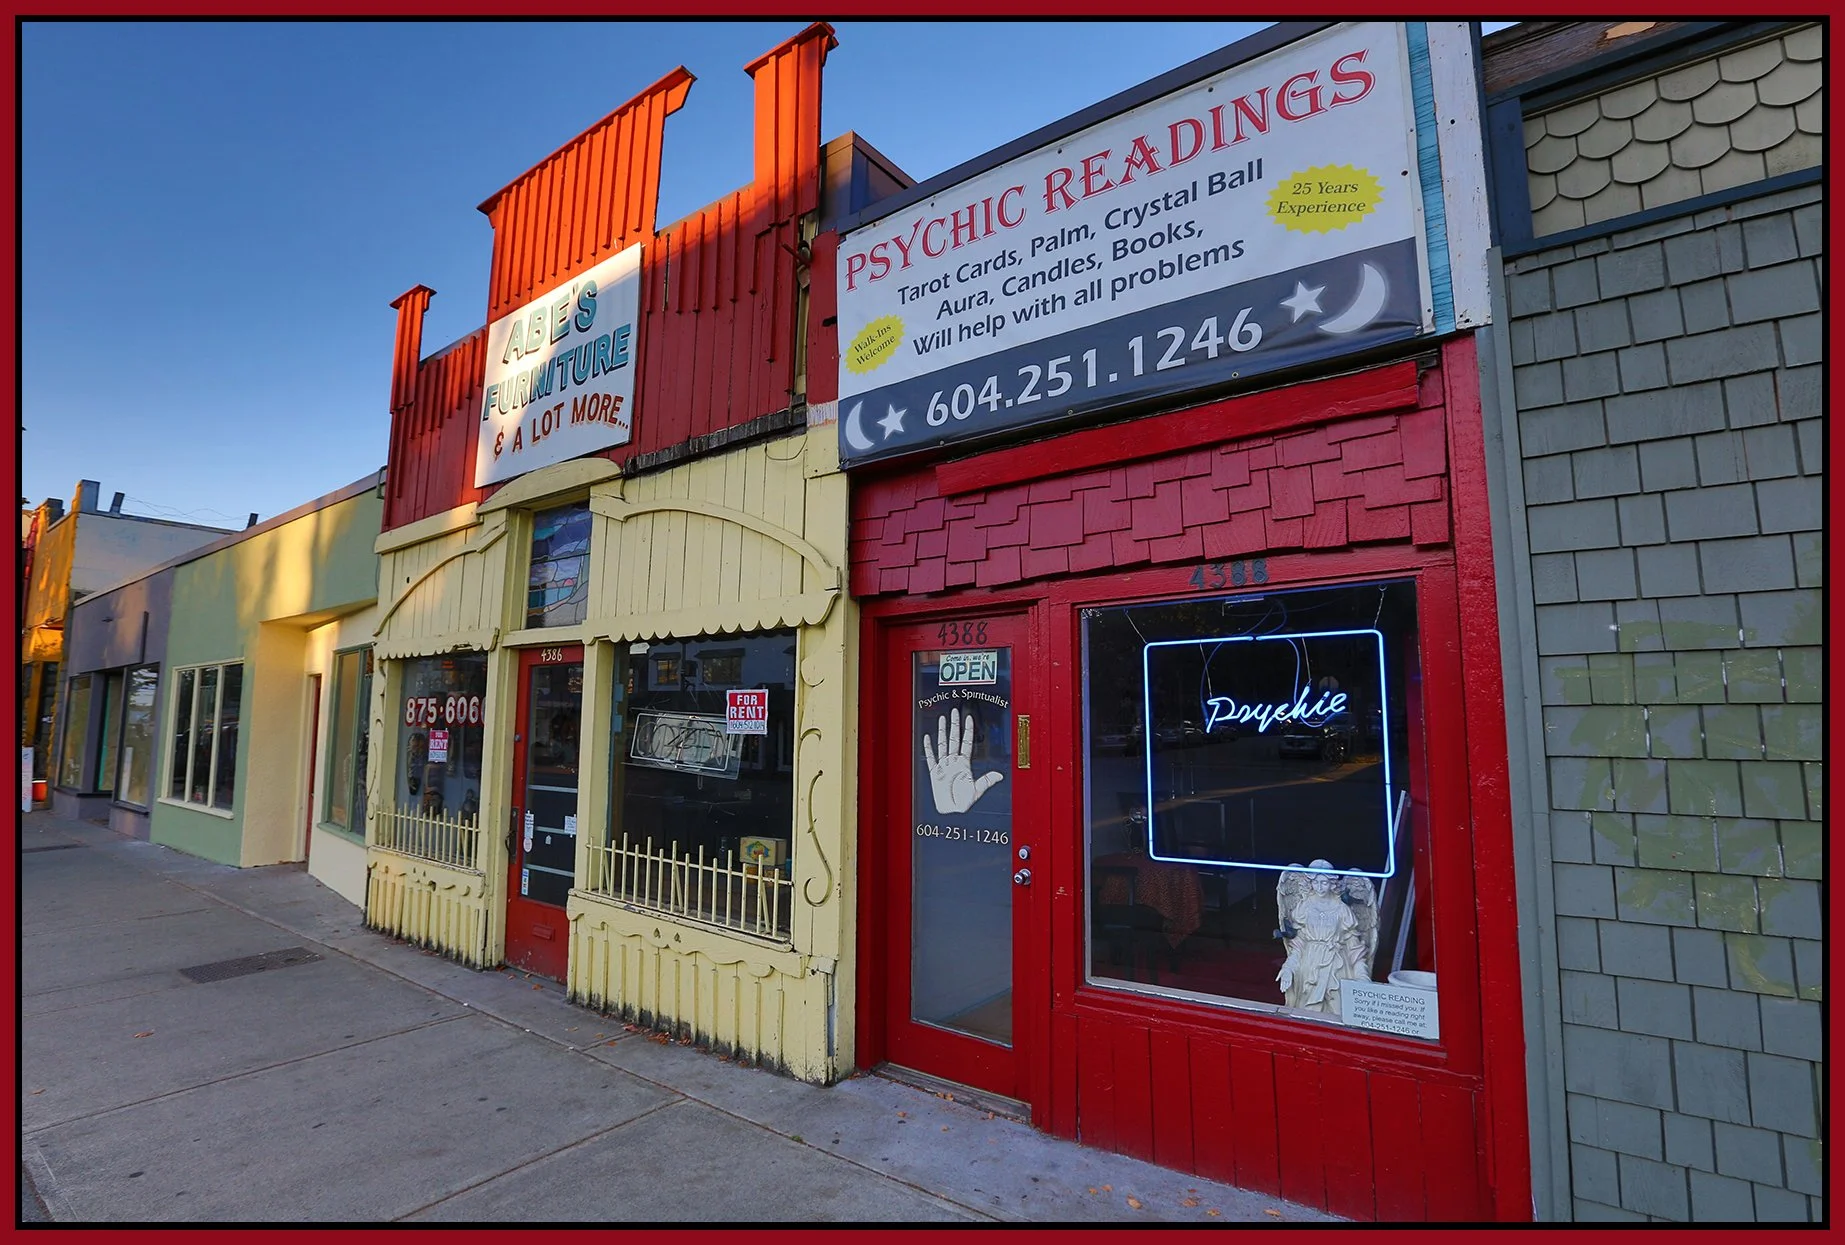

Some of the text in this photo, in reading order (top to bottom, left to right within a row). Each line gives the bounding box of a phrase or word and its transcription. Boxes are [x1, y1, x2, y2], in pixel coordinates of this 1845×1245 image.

[845, 48, 1376, 292] PSYCHIC READINGS
[1292, 181, 1359, 195] 25 Years
[1276, 201, 1366, 217] Experience
[897, 158, 1263, 305] Tarot Cards, Palm, Crystal Ball
[936, 220, 1203, 320] Aura, Candles, Books,
[913, 239, 1245, 357] Will help with all problems
[502, 279, 598, 364] ABE'S
[854, 325, 892, 352] Walk-Ins
[856, 336, 895, 364] Welcome
[483, 323, 631, 421] FURNITURE
[926, 307, 1263, 427] 604.251.1246
[494, 426, 504, 459] &
[512, 427, 523, 453] A
[532, 402, 565, 443] LOT
[1188, 558, 1269, 590] 4388
[937, 621, 988, 646] 4388
[541, 648, 563, 662] 4386
[945, 654, 961, 662] Come
[940, 661, 996, 682] OPEN
[737, 694, 758, 706] FOR
[918, 689, 1009, 710] Psychic & Spiritualist
[1207, 686, 1347, 733] Psychic
[730, 706, 764, 719] RENT
[429, 738, 449, 750] RENT
[916, 823, 1009, 845] 604-251-1246
[1352, 989, 1425, 1005] PSYCHIC READING
[1354, 998, 1370, 1006] Sorry
[1381, 1002, 1403, 1010] missed
[1372, 1014, 1393, 1023] please
[1385, 1009, 1409, 1019] reading
[1410, 1012, 1425, 1020] right
